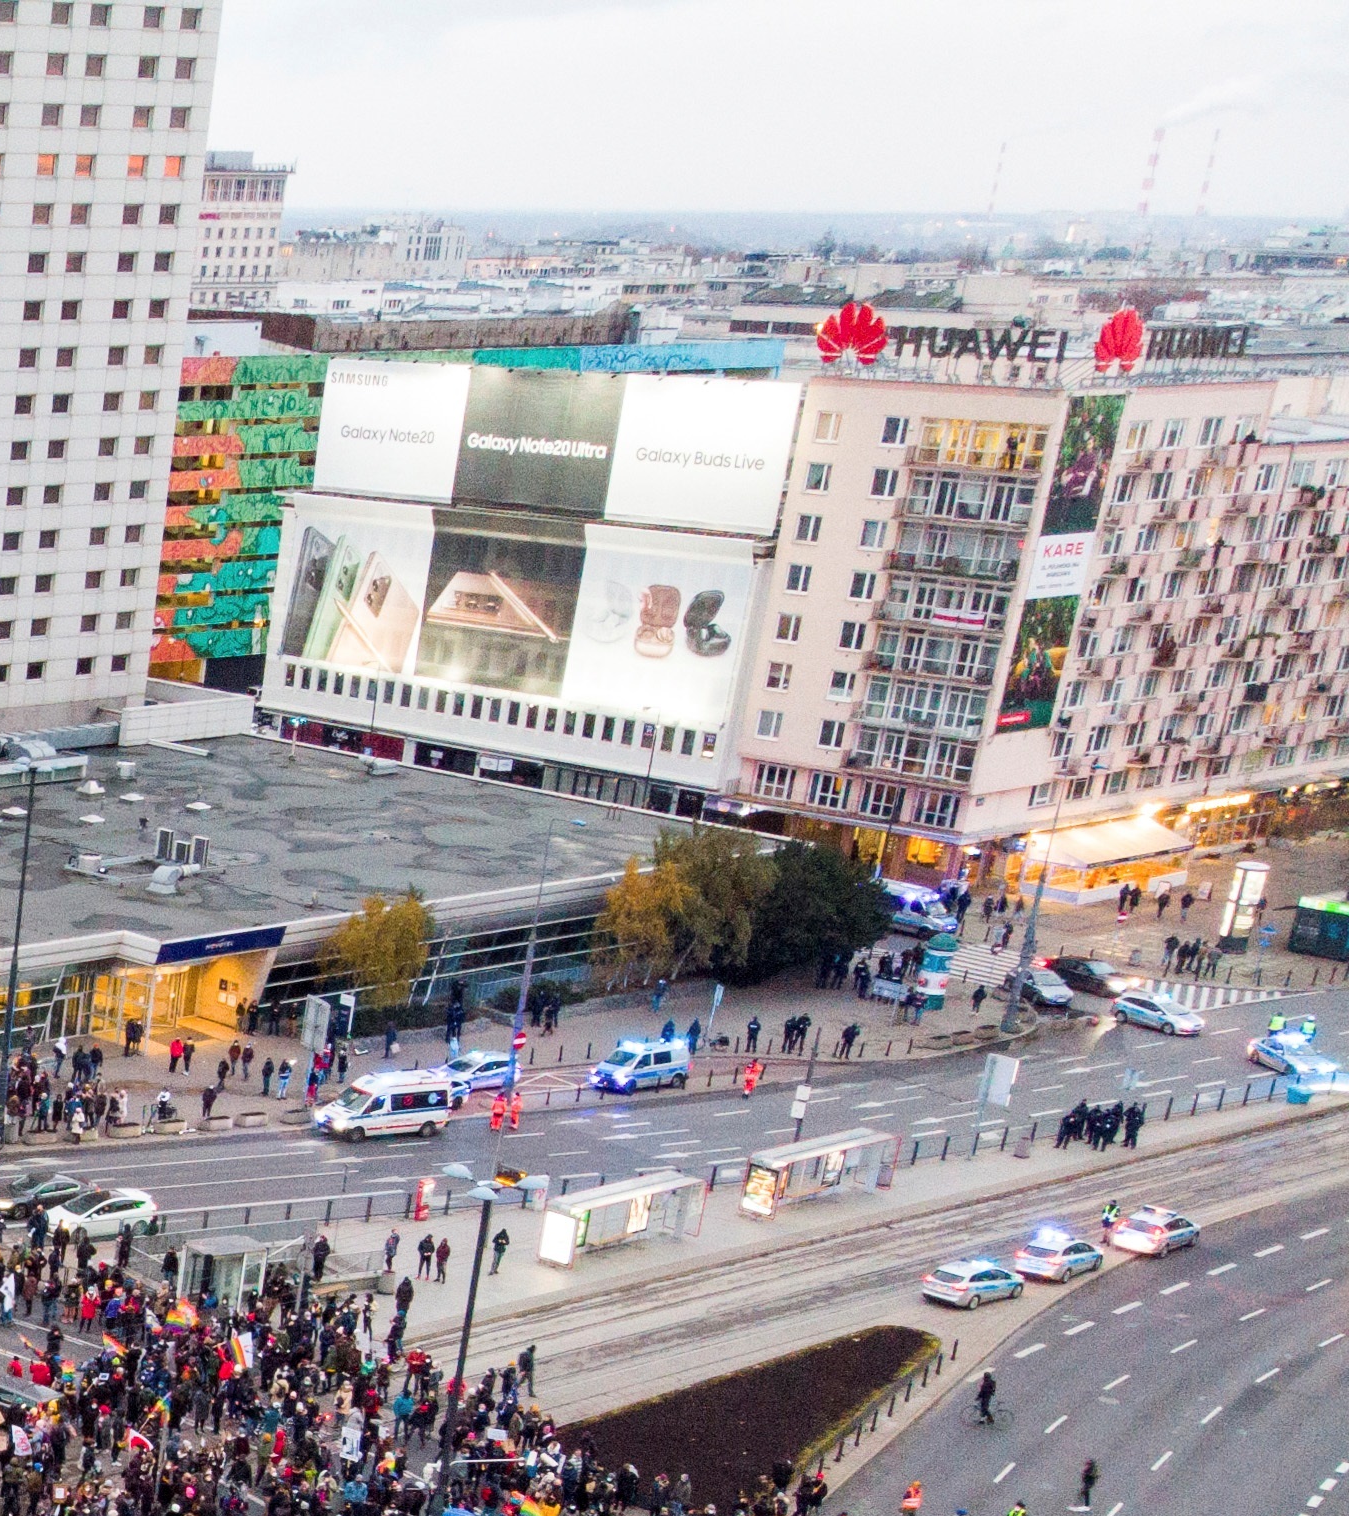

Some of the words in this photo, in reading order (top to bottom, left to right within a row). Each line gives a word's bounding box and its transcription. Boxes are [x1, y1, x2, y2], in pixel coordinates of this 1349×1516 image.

[893, 325, 1070, 364] HUAWEI
[1146, 326, 1250, 361] HUAWEI
[330, 371, 389, 387] SAMSUNG
[340, 425, 387, 443] Galaxy
[389, 427, 435, 444] Note20
[467, 431, 518, 453] Galaxy
[519, 436, 571, 458] Note20
[571, 441, 607, 460] Ultra
[636, 447, 692, 467] Galaxy
[694, 452, 732, 468] Buds
[734, 455, 765, 471] Live
[1043, 541, 1085, 559] KARE
